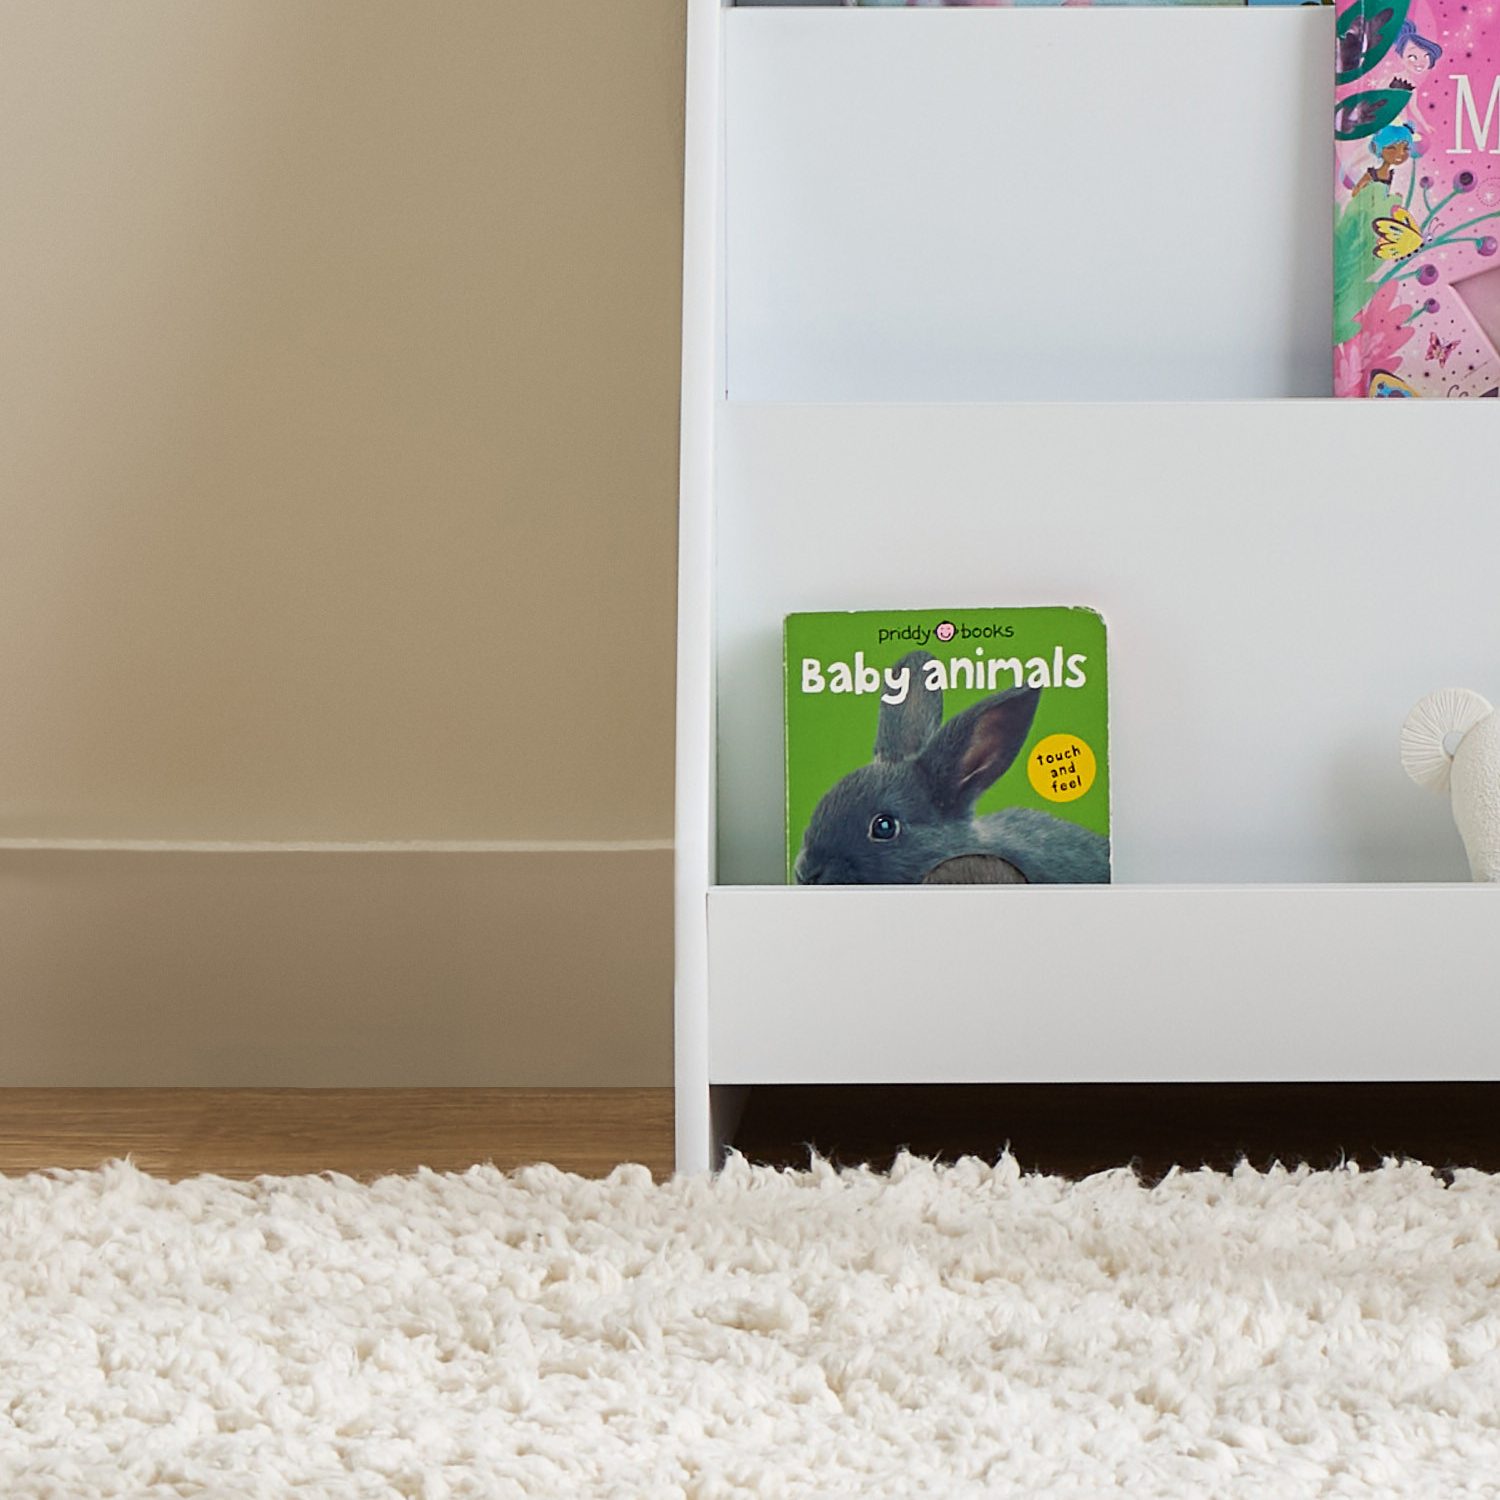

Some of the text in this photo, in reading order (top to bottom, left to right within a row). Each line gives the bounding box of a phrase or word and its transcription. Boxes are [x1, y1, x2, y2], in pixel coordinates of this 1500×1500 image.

[878, 623, 1014, 645] priddy books
[801, 646, 1088, 705] Baby animals
[1037, 744, 1081, 766] touch
[1050, 761, 1076, 778] and
[1052, 775, 1081, 793] feel
